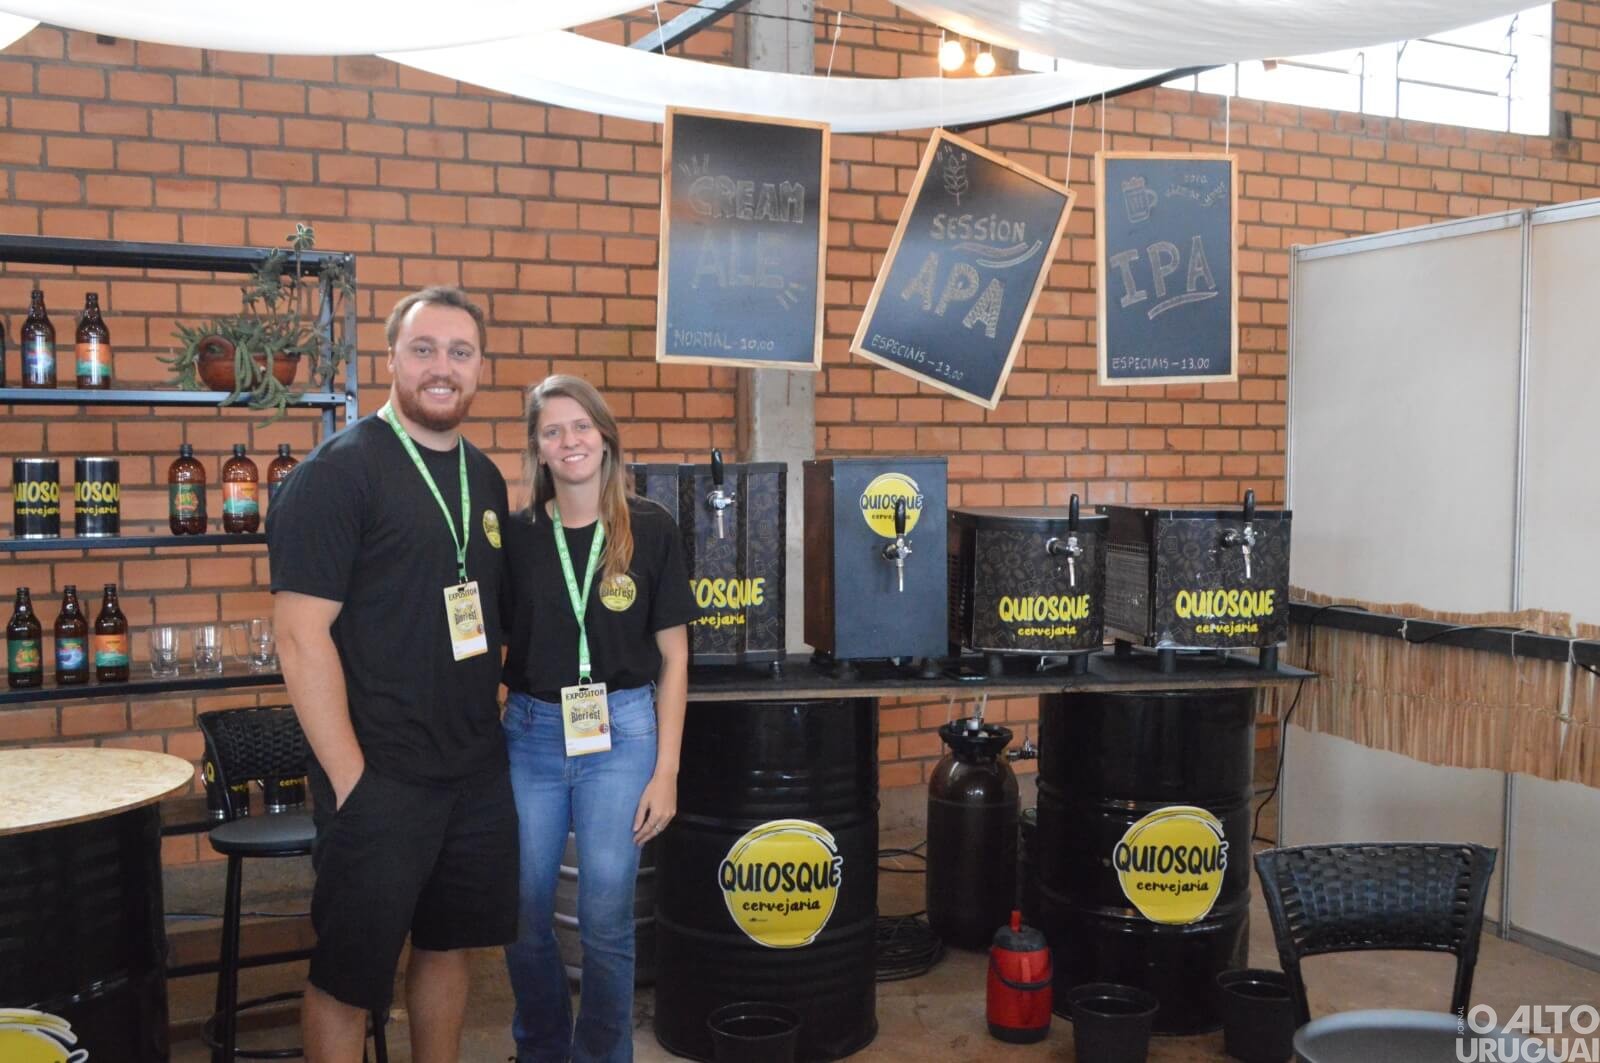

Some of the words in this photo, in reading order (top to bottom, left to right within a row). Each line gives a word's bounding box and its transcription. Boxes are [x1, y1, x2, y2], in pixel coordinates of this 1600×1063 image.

[688, 175, 806, 224] CREAM
[691, 229, 786, 289] ALE
[1109, 235, 1217, 308] IPA
[901, 250, 1005, 339] APA
[673, 329, 733, 351] NORMAL
[1111, 356, 1169, 370] ESPECIAIS
[14, 481, 59, 503] UIOSQ
[75, 481, 120, 503] IOSQU
[16, 505, 60, 518] cervejar
[75, 505, 118, 517] rvejaria
[689, 577, 766, 610] OSQUE
[1175, 588, 1276, 619] QUIOSQUE
[998, 594, 1090, 623] QUIOSQUE
[689, 612, 746, 629] vejaria
[1195, 621, 1260, 637] cervejaria
[1017, 624, 1078, 640] cervejaria
[565, 688, 605, 700] EXPOSITOR
[1114, 841, 1228, 875] QUIOSQUE
[719, 857, 842, 892] QUIOSQUE
[1136, 880, 1210, 897] cervejaria
[742, 897, 821, 916] cervejaria
